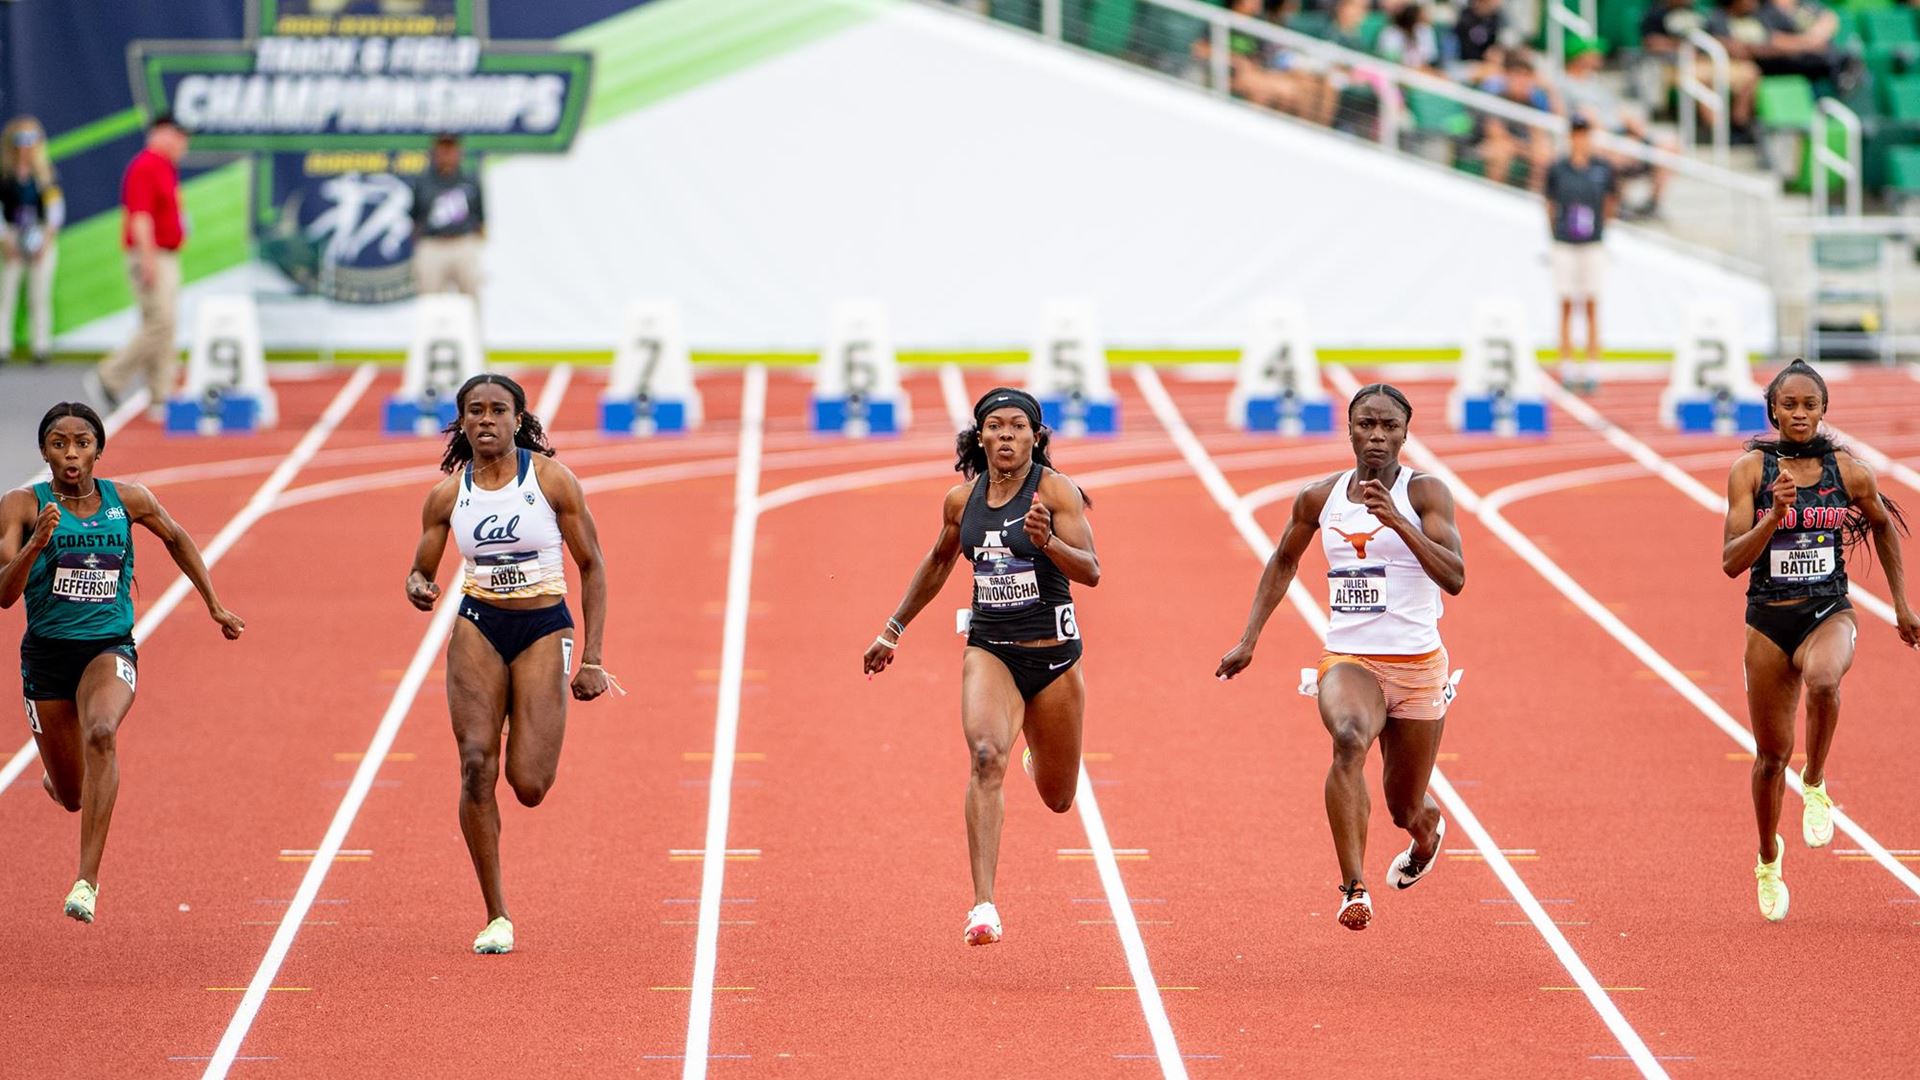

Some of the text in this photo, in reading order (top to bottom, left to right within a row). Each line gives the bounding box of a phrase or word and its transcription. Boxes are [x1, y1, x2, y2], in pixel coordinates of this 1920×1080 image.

[256, 36, 358, 73] TRACK
[389, 36, 481, 73] FIELD
[173, 74, 568, 132] CHAMPIONSHIPS
[207, 338, 239, 385] 9
[426, 340, 457, 388] 8
[638, 339, 661, 390] 7
[842, 341, 872, 391] 6
[1050, 339, 1081, 391] 5
[1262, 343, 1293, 388] 4
[1483, 338, 1513, 391] 3
[1693, 339, 1725, 389] 2
[57, 534, 124, 548] COASTAL
[473, 514, 520, 542] Cal
[1780, 559, 1826, 575] BATTLE
[1788, 550, 1819, 560] ANAVIA
[54, 578, 117, 596] JEFFERSON
[70, 570, 106, 581] MELISSA
[491, 571, 527, 587] ABBA
[989, 575, 1017, 585] GRACE
[1343, 579, 1368, 589] JULIEN
[1335, 588, 1379, 604] ALFRED
[1060, 607, 1076, 638] 6
